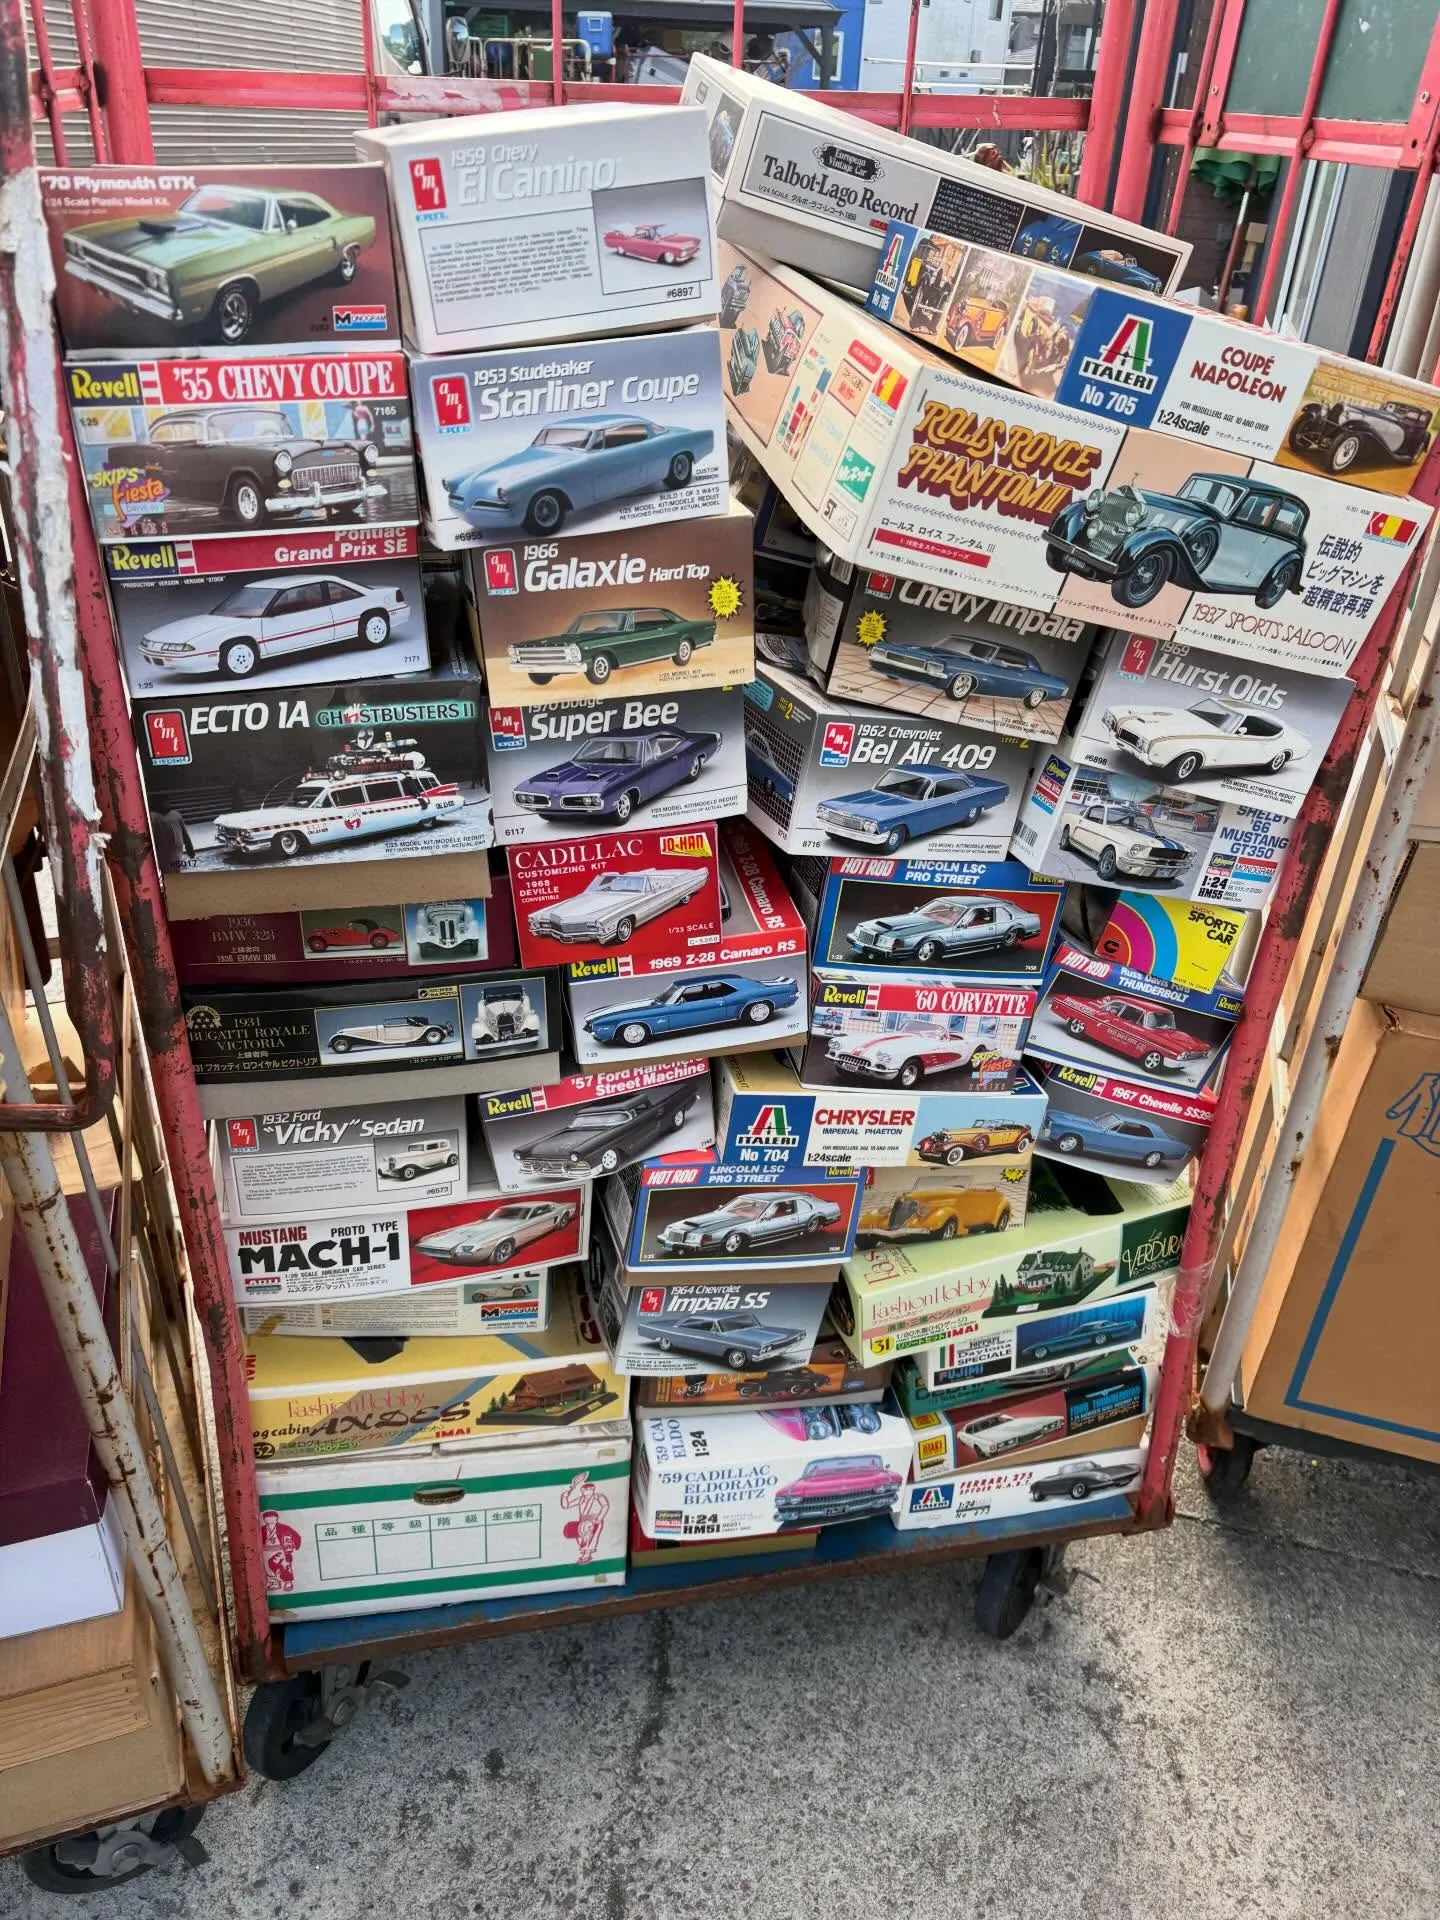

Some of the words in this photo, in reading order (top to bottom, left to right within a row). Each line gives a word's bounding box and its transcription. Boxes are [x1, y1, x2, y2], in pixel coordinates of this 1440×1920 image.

[451, 147, 486, 168] 1959
[491, 143, 539, 163] Chevy
[855, 166, 867, 176] Car
[73, 175, 156, 193] Plymouth
[158, 175, 196, 190] GTX
[458, 166, 489, 207] El
[492, 156, 618, 201] Camino
[763, 154, 858, 207] Talbot-Lago
[859, 187, 919, 224] Record
[771, 189, 788, 199] SCALE
[1221, 346, 1275, 376] COUPÉ
[172, 367, 212, 401] '55
[217, 364, 304, 399] CHEVY
[310, 361, 395, 397] COUPE
[474, 369, 507, 387] 1953
[510, 360, 594, 382] Studebaker
[1082, 360, 1156, 392] ITALERI
[1191, 361, 1287, 404] NAPOLEON
[71, 368, 139, 400] Revell
[480, 379, 614, 421] Starliner
[622, 373, 700, 404] Coupe
[1081, 384, 1104, 407] No
[1108, 390, 1139, 415] 705
[374, 405, 397, 416] 7165
[1180, 400, 1191, 410] FOR
[1222, 411, 1233, 421] AGE
[1242, 417, 1253, 427] AND
[1157, 408, 1210, 437] 1:24scale
[913, 400, 1007, 460] ROLLS
[998, 425, 1102, 490] ROYCE
[696, 466, 719, 475] CUSTOM
[704, 487, 720, 496] WAYS
[634, 503, 656, 511] MODEL
[698, 494, 720, 502] REDUIT
[619, 512, 649, 520] RETOUCHED
[650, 509, 667, 517] PHOTO
[678, 504, 700, 513] ACTUAL
[111, 544, 175, 571] Revell
[275, 546, 333, 562] Grand
[341, 542, 377, 557] Prix
[384, 540, 407, 553] SE
[524, 543, 558, 560] 1966
[1316, 534, 1362, 564] 伝説的
[524, 554, 646, 592] Galaxie
[650, 565, 683, 583] Hard
[686, 563, 710, 580] Top
[1303, 561, 1384, 596] ビッグマシンを
[1301, 585, 1374, 620] 超精密再現
[988, 599, 1086, 643] Impala
[1226, 612, 1283, 642] SPORTS
[1159, 642, 1190, 657] 1969
[404, 655, 420, 663] 7171
[1150, 653, 1228, 697] Hurst
[1228, 673, 1288, 710] Olds
[189, 703, 269, 735] ECTO
[278, 700, 310, 729] 1A
[530, 708, 617, 741] Super
[622, 701, 679, 730] Bee
[857, 724, 886, 737] 1962
[889, 726, 942, 741] Chevrolet
[852, 739, 892, 764] Bel
[898, 740, 940, 766] Air
[941, 744, 997, 770] 409
[1233, 781, 1249, 789] MODEL
[463, 834, 485, 842] REDUIT
[505, 827, 525, 836] 6117
[1220, 827, 1289, 849] MUSTANG
[802, 840, 820, 848] 8716
[1230, 843, 1274, 859] GT350
[515, 839, 643, 869] CADILLAC
[517, 863, 586, 879] CUSTOMIZING
[591, 861, 607, 870] KIT
[906, 860, 959, 873] LINCOLN
[962, 862, 986, 874] LSC
[525, 880, 551, 888] 1968
[905, 871, 931, 882] PRO
[934, 872, 979, 885] STREET
[1202, 875, 1228, 889] 1:24
[519, 886, 560, 897] DEVILLE
[521, 894, 560, 903] CONVERTIBLE
[750, 877, 776, 915] Camaro
[1198, 888, 1224, 899] HM55
[228, 917, 256, 927] 1936
[668, 926, 685, 934] 1/25
[686, 922, 714, 931] SCALE
[1188, 911, 1239, 934] SPORTS
[1207, 929, 1233, 945] CAR
[649, 957, 681, 969] 1969
[686, 952, 716, 965] Z-28
[720, 946, 773, 961] Camaro
[777, 940, 797, 953] RS
[571, 957, 617, 977] Revell
[824, 985, 865, 1005] Revell
[1118, 976, 1189, 1002] THUNDERBOLT
[915, 990, 938, 1012] '60
[942, 992, 1029, 1015] CORVETTE
[1218, 996, 1240, 1012] Revell
[233, 1017, 261, 1028] 1931
[189, 1029, 249, 1041] BUGATTI
[255, 1024, 311, 1038] ROYALE
[216, 1038, 286, 1050] VICTORIA
[243, 1060, 280, 1070] ロワイヤル
[281, 1057, 318, 1067] ビクトリア
[596, 1079, 640, 1096] Street
[642, 1062, 705, 1087] Machine
[598, 1069, 631, 1086] Ford
[1058, 1067, 1095, 1089] Revell
[487, 1094, 532, 1116] Revell
[1112, 1087, 1136, 1102] 1967
[1139, 1094, 1183, 1114] Chevelle
[262, 1112, 290, 1125] 1932
[292, 1110, 321, 1123] Ford
[815, 1109, 917, 1125] CHRYSLER
[360, 1117, 425, 1137] Sedan
[737, 1136, 798, 1145] ITALERI
[740, 1148, 759, 1161] No
[763, 1149, 789, 1161] 704
[710, 1165, 760, 1174] LINCOLN
[763, 1164, 785, 1172] LSC
[708, 1174, 731, 1184] PRO
[737, 1174, 779, 1183] STREET
[239, 1226, 308, 1246] MUSTANG
[331, 1224, 365, 1238] PROTO
[372, 1221, 398, 1234] TYPE
[238, 1232, 400, 1274] MACH-1
[321, 1268, 350, 1276] AMERICAN
[671, 1286, 694, 1295] 1964
[695, 1285, 741, 1294] Chevrolet
[667, 1294, 740, 1313] Impala
[741, 1292, 771, 1309] SS
[947, 1324, 979, 1338] IMAI
[958, 1348, 1012, 1365] SPECIALE
[435, 1427, 471, 1438] IMAI
[689, 1430, 710, 1457] 1:24
[685, 1465, 771, 1483] CADILLAC
[960, 1475, 1009, 1489] FERRARI
[1012, 1472, 1034, 1481] 275
[684, 1476, 778, 1494] ELDORADO
[684, 1490, 766, 1505] BIARRITZ
[683, 1513, 718, 1525] 1:24
